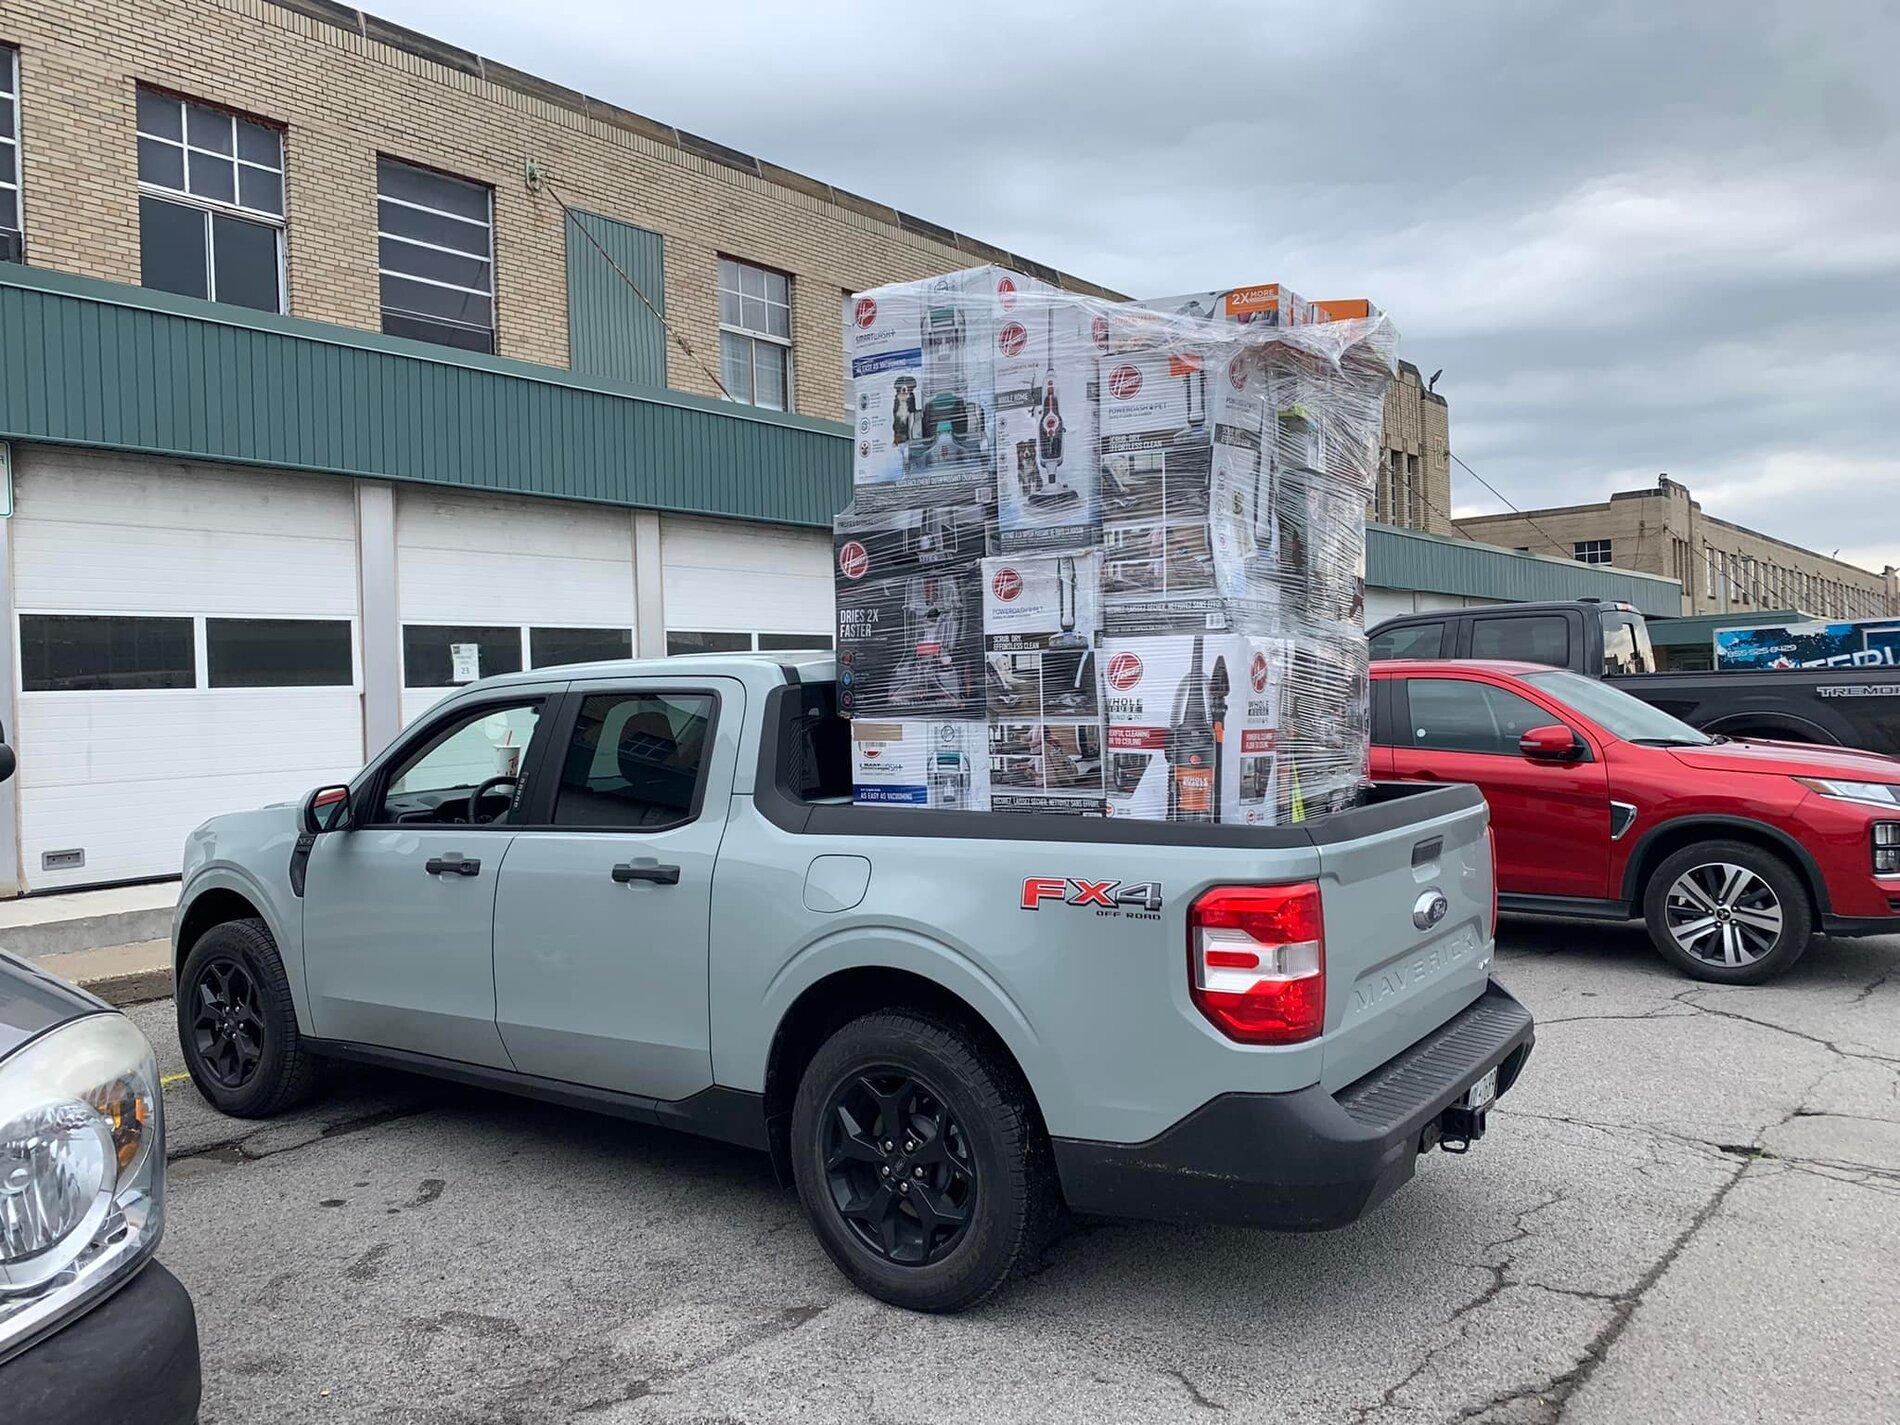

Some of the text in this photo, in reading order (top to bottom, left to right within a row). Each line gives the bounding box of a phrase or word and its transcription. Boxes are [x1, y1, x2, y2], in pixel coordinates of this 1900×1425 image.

[1231, 291, 1250, 305] 2X
[840, 608, 879, 623] DRIES 2X
[840, 624, 872, 638] FASTER
[1020, 876, 1162, 911] FX4
[1096, 910, 1162, 920] OFF ROAD
[1354, 931, 1475, 1013] MAVERICK
